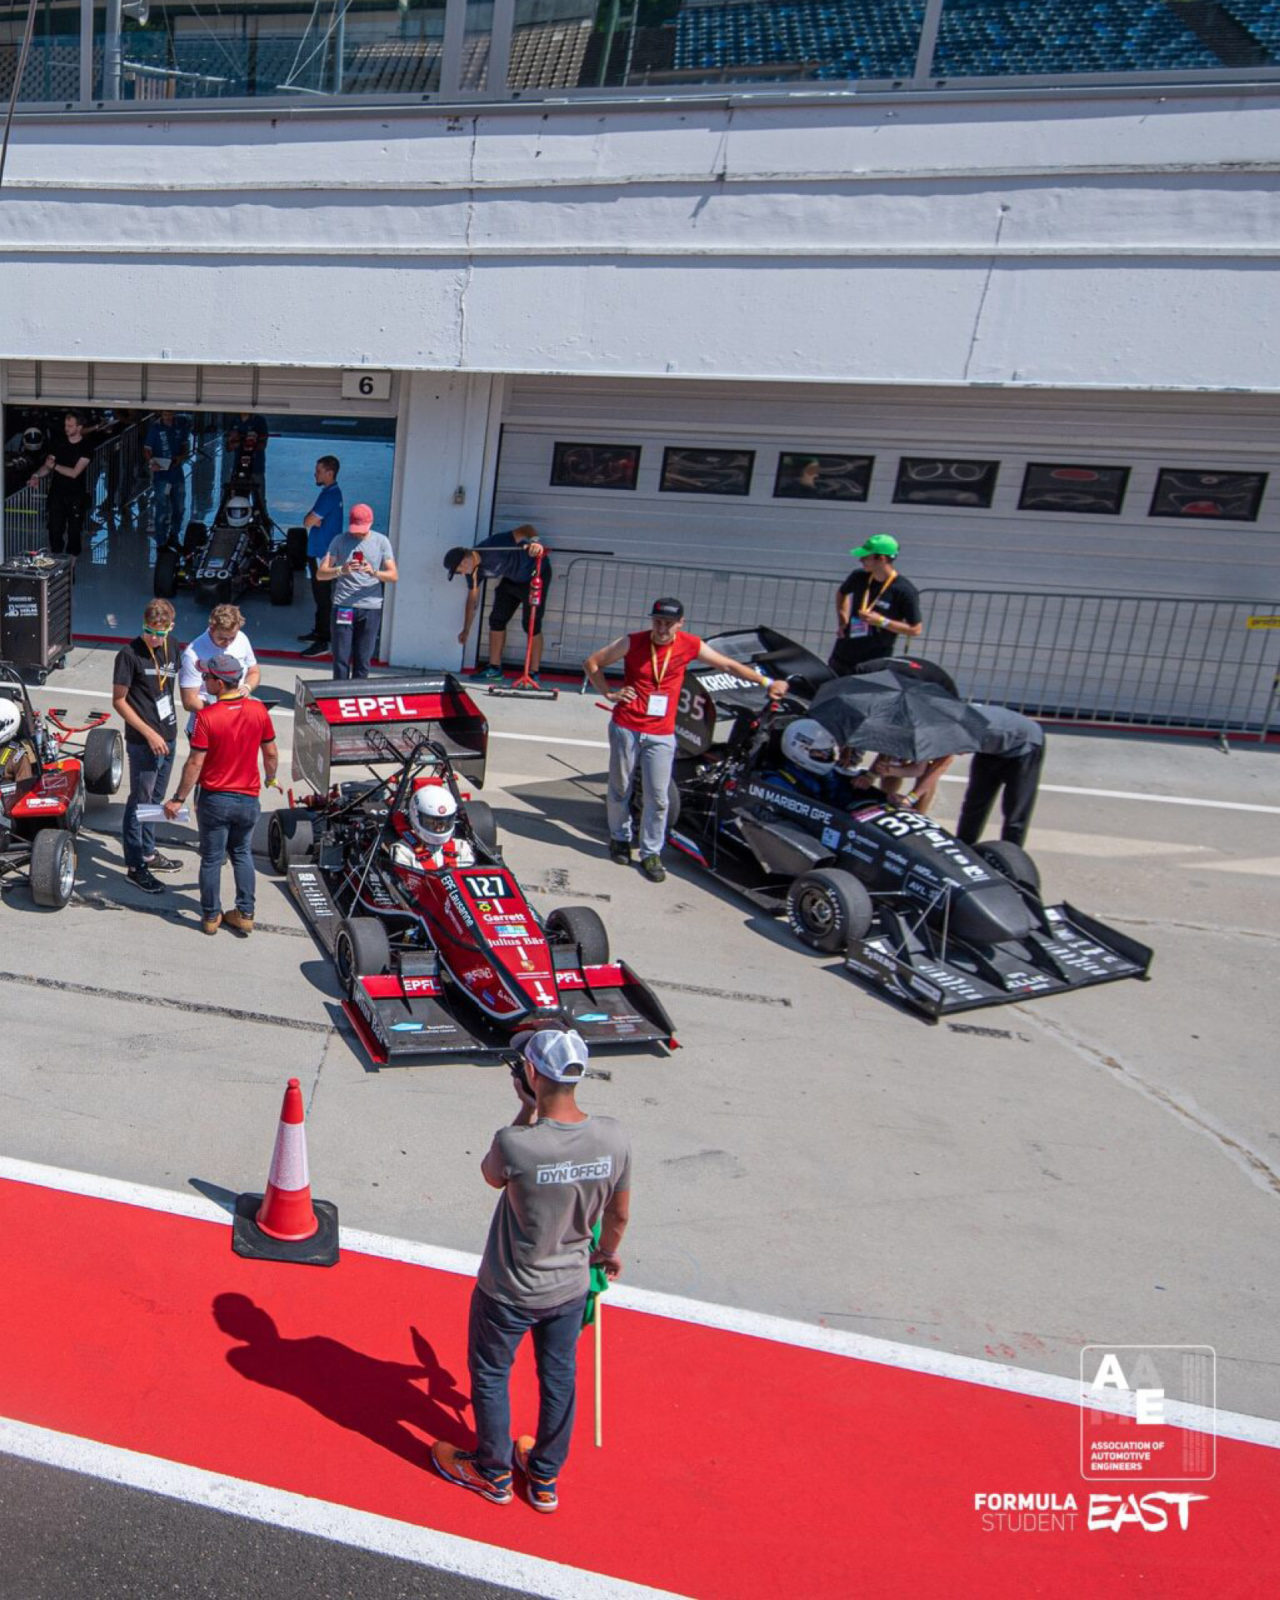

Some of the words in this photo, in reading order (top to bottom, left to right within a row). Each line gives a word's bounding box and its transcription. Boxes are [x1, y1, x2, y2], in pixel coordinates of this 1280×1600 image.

[358, 376, 374, 395] 6
[195, 569, 230, 580] E60
[338, 695, 418, 718] EPFL
[748, 784, 766, 800] UNI
[764, 789, 811, 817] MARIBOR
[809, 807, 834, 826] GPE
[465, 876, 506, 897] 127
[440, 874, 457, 892] EPF
[449, 888, 475, 928] Lausanne
[482, 913, 527, 922] Garrett
[487, 938, 522, 948] Julius
[403, 979, 441, 992] EPFL
[556, 971, 584, 984] PFL
[540, 1168, 568, 1183] DYN
[569, 1162, 610, 1179] OFFCR
